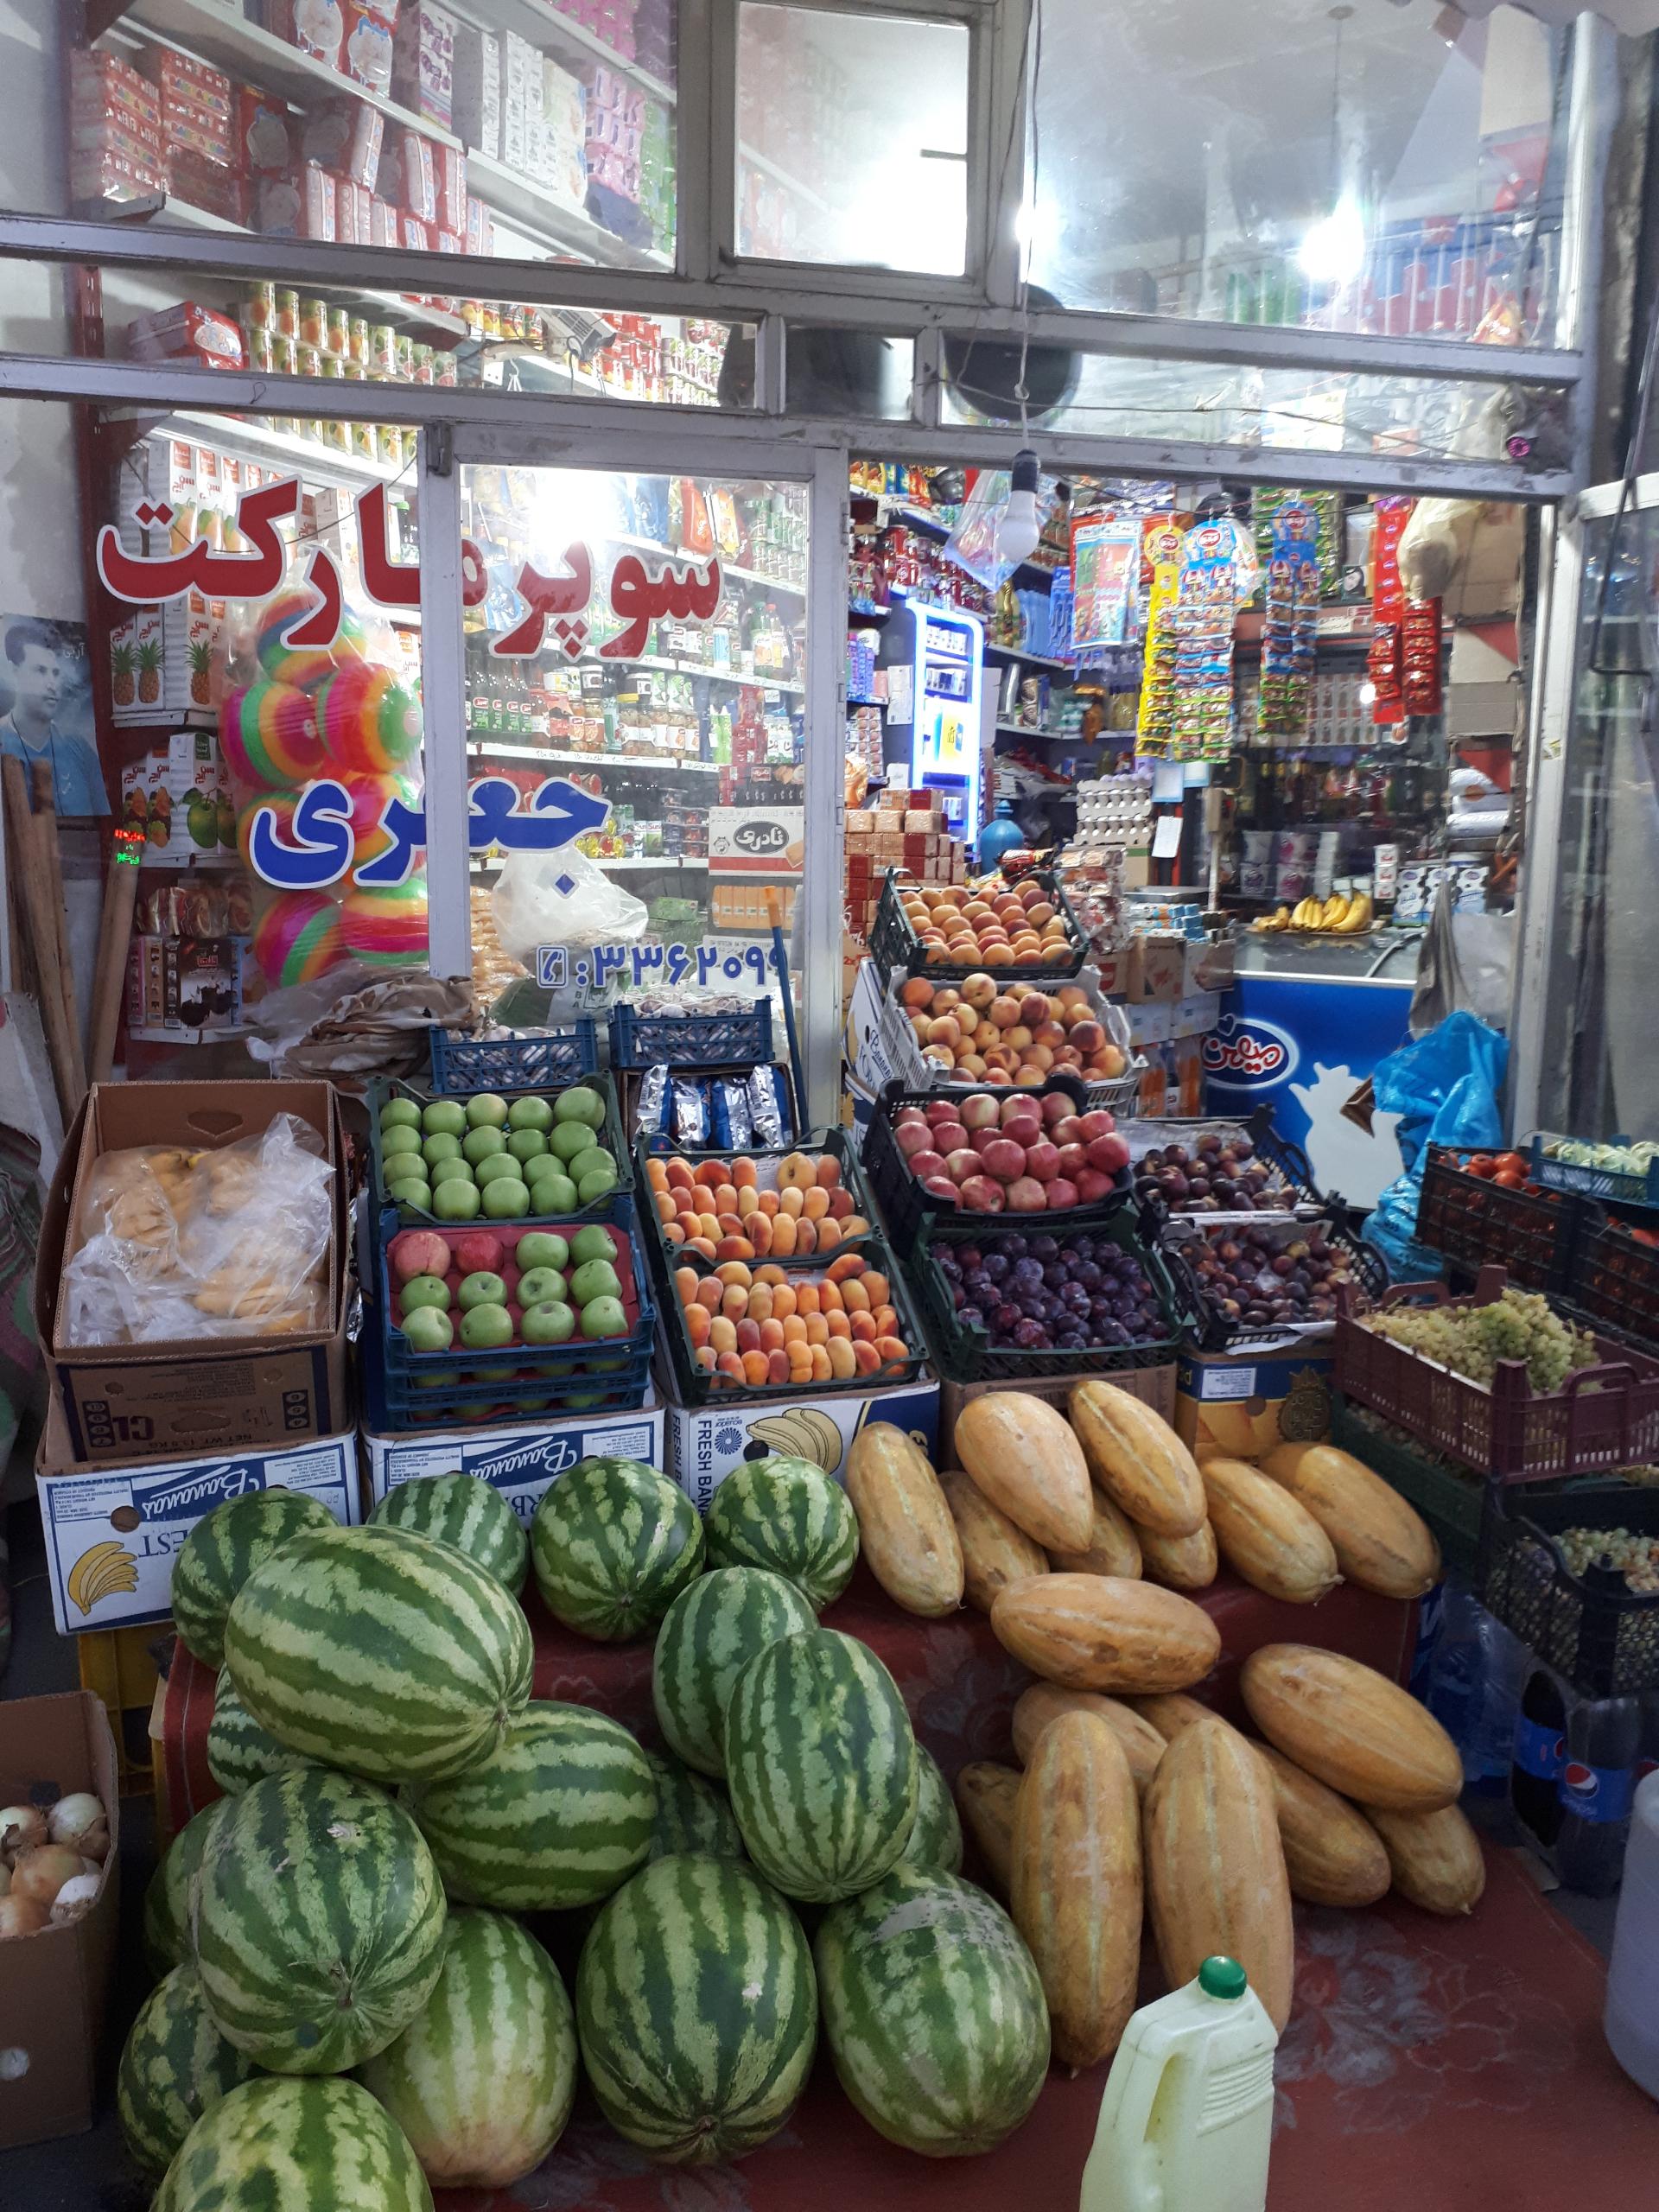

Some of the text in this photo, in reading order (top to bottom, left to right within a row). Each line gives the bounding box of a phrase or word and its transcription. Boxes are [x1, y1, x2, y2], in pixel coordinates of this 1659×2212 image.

[250, 776, 614, 898] جعری
[735, 826, 785, 851] نادری
[1200, 1035, 1285, 1075] میهن
[469, 1439, 578, 1480] Bananas
[671, 1414, 682, 1467] FRESH
[697, 1420, 712, 1470] FRESH
[141, 1468, 260, 1521] Bananas
